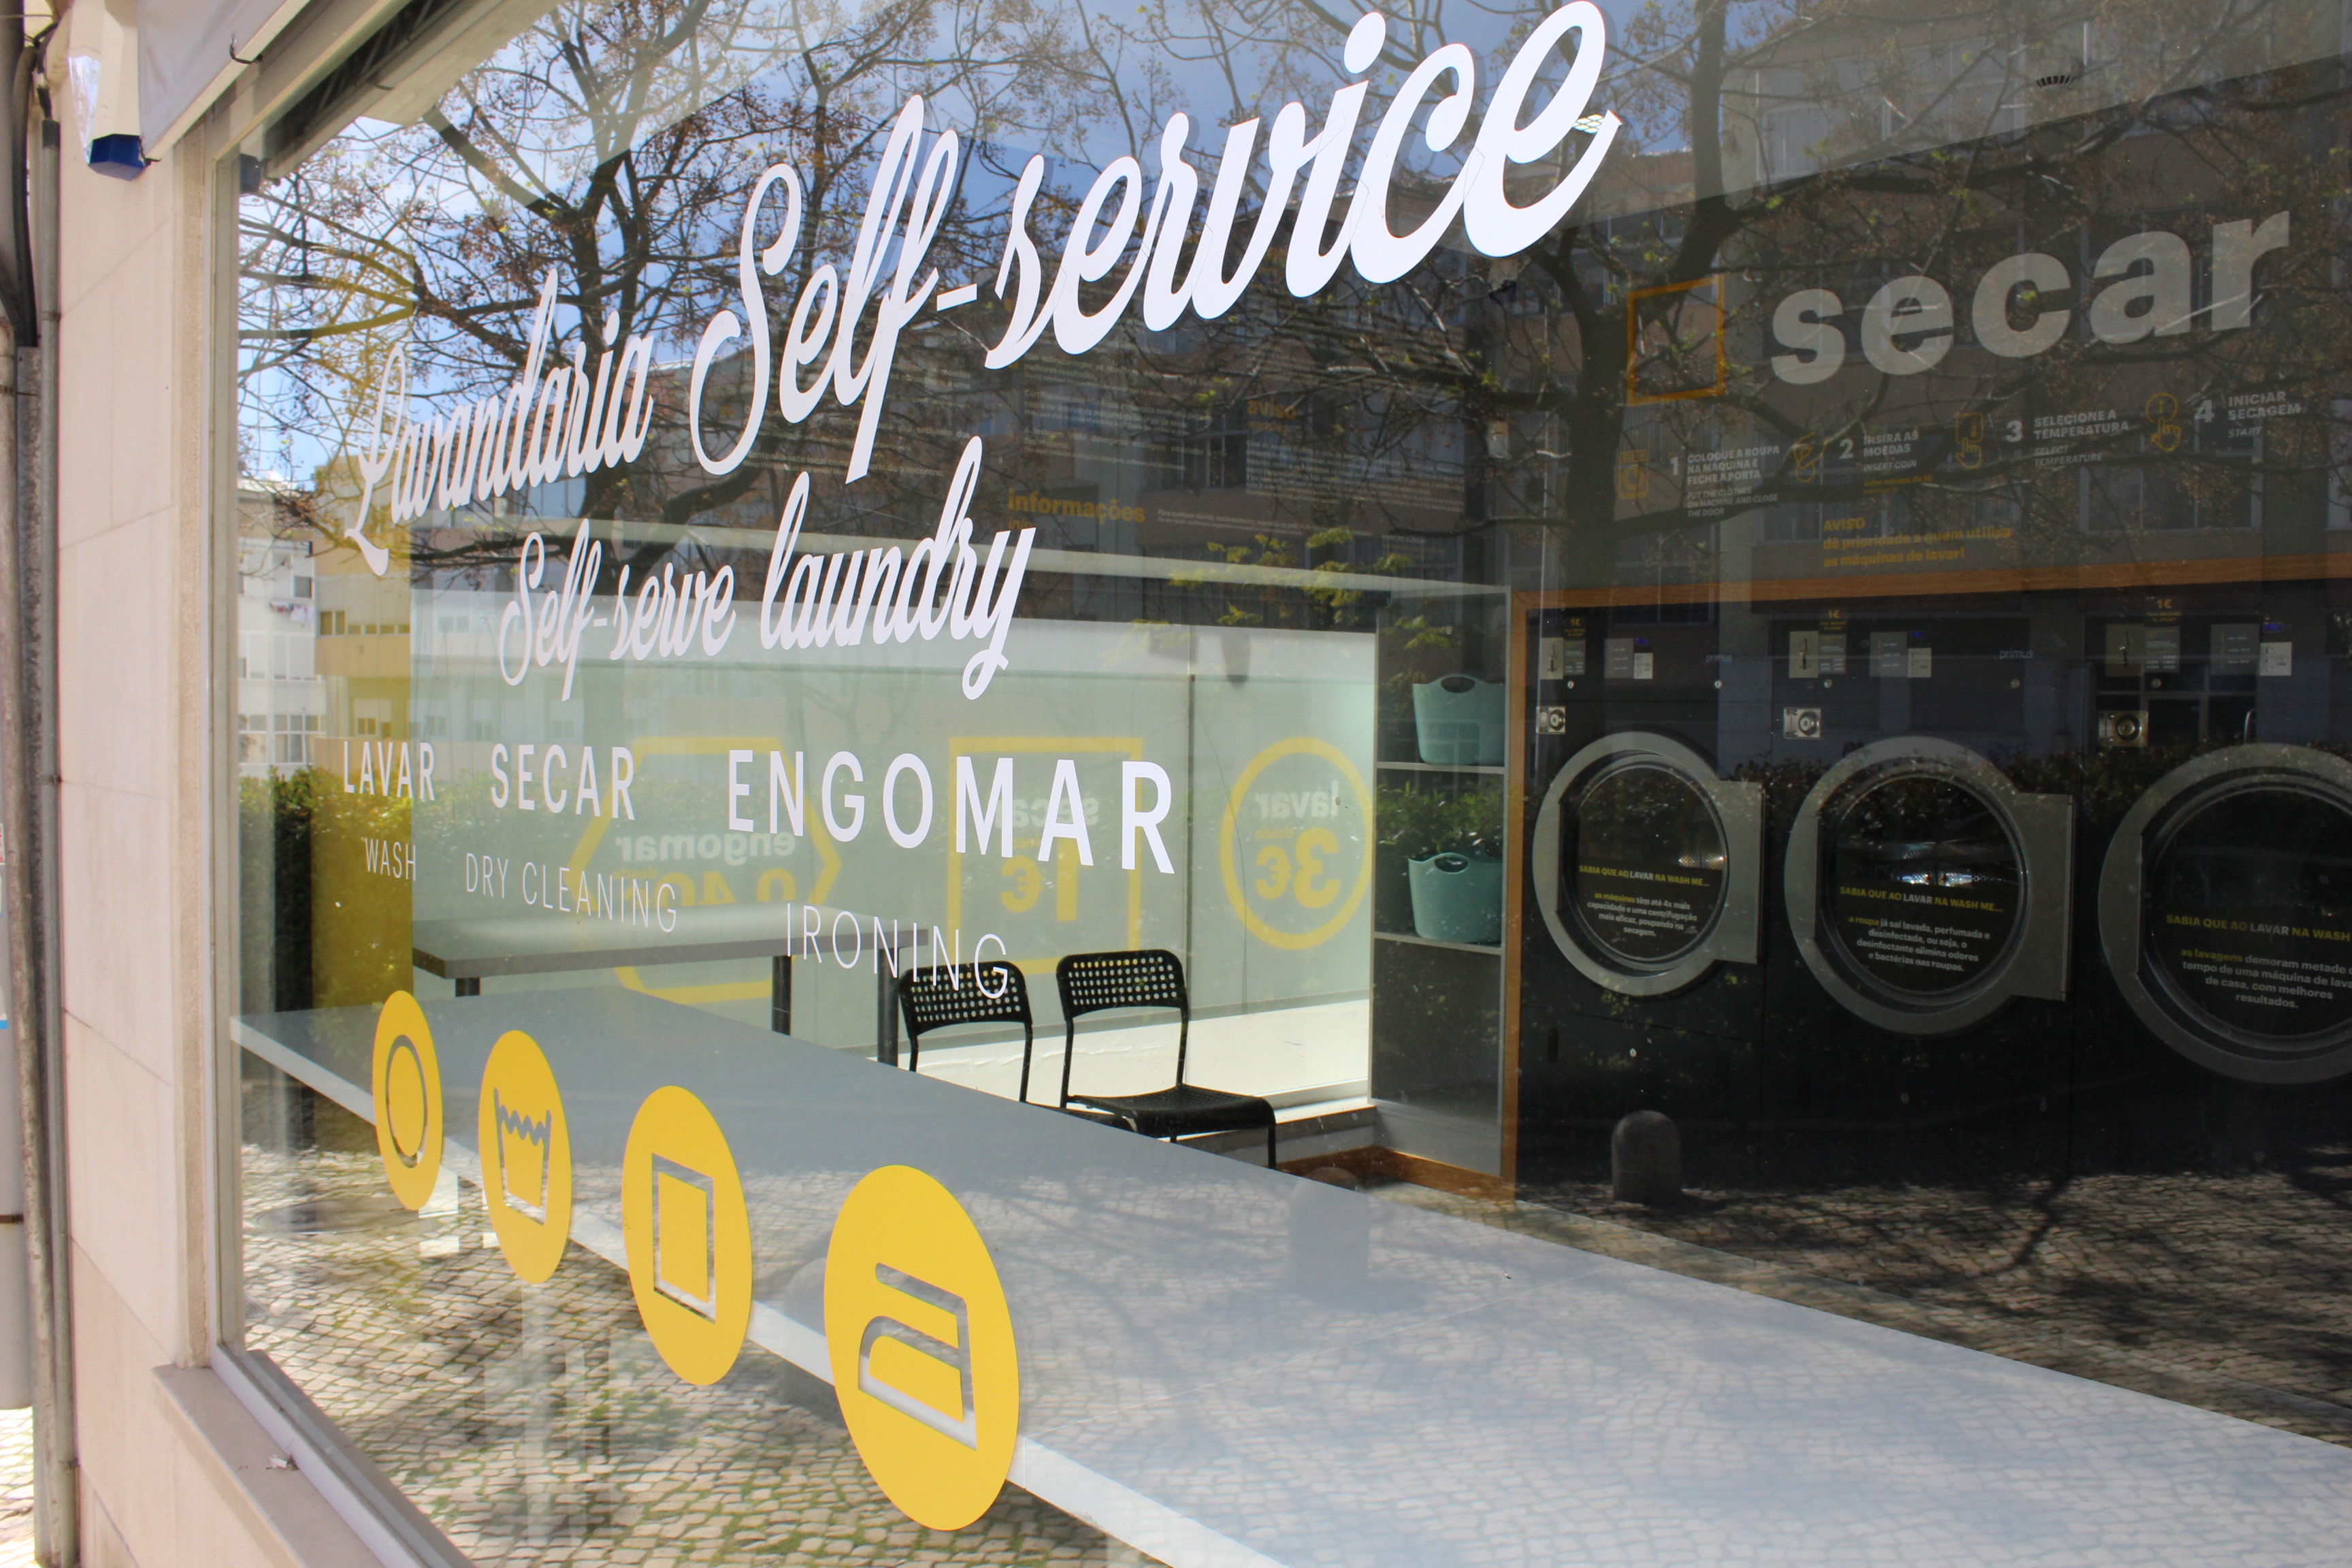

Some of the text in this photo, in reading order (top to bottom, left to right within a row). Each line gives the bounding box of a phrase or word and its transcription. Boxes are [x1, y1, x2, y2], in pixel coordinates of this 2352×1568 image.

[344, 1, 1622, 576] Lavandaria Self-service
[1771, 211, 2289, 385] secar
[2228, 391, 2287, 408] INICIAR
[2034, 410, 2117, 429] SELECIONE A
[2195, 399, 2215, 424] 4
[2227, 403, 2302, 421] SECAGEM
[1863, 429, 1920, 446] INSIRA AS
[2006, 419, 2023, 442] 3
[2034, 421, 2129, 440] TEMPERATURA
[2227, 426, 2262, 440] START
[1686, 449, 1735, 464] COLOQUE
[1744, 444, 1780, 457] ROUPA
[1839, 437, 1855, 460] 2
[1863, 443, 1912, 457] MOEDAS
[2034, 445, 2070, 457] SELECT
[1670, 455, 1679, 476] 1
[1863, 459, 1918, 472] INSERT COIN
[2034, 453, 2103, 468] TEMPERATURE
[1686, 473, 1718, 486] FECHE
[1728, 469, 1762, 481] PORTA
[1703, 489, 1718, 498] THE
[1735, 495, 1752, 504] AND
[1752, 493, 1779, 503] CLOSE
[1008, 487, 1146, 525] informações
[1687, 508, 1725, 518] THE DOOR
[1823, 517, 1866, 532] AVISO
[1842, 532, 1912, 551] prioridade
[1923, 529, 1963, 544] quem
[1823, 546, 1965, 568] as máquinas de lavar!
[499, 436, 1036, 702] Self-serve laundry
[2156, 598, 2172, 609] 1€
[1999, 648, 2034, 659] primus
[344, 740, 1175, 875] LAVAR SECAR ENGOMAR
[365, 837, 416, 881] WASH
[1578, 864, 1601, 875] SABIA
[1601, 867, 1618, 877] QUE
[1618, 869, 1629, 879] AO
[1630, 870, 1654, 881] LAVAR
[1654, 873, 1666, 882] NA
[1667, 875, 1690, 885] WASH
[466, 852, 677, 933] DRY CLEANING
[1603, 894, 1635, 904] máquinas
[1650, 898, 1662, 906] até
[1663, 899, 1672, 907] 4x
[1673, 900, 1690, 910] mais
[1839, 885, 2004, 913] SABIA QUE AO LAVAR NA WASH ME...
[1587, 900, 1626, 913] capacidade
[1631, 907, 1647, 915] uma
[1648, 909, 1697, 922] centrifugação
[1599, 912, 1614, 921] mais
[1638, 919, 1674, 930] poupando
[1674, 922, 1684, 930] na
[1623, 926, 1657, 937] secagem.
[1855, 917, 1879, 927] roupa
[1880, 918, 1889, 928] já
[1889, 919, 1901, 929] sai
[1903, 920, 1933, 933] lavada,
[1933, 926, 1982, 939] perfumada
[2166, 913, 2352, 942] SABIA QUE AO LAVAR NA WASH
[1867, 928, 1925, 944] desinfectada,
[1926, 936, 1938, 945] ou
[1939, 938, 1959, 949] seja,
[785, 902, 1010, 1000] IRONING
[1856, 938, 1979, 962] desinfectante elimina odores
[1875, 951, 1914, 965] bactérias
[1915, 958, 1931, 967] nas
[1931, 960, 1965, 972] roupas.
[2180, 948, 2193, 958] as
[2194, 947, 2243, 963] lavagens
[2244, 954, 2299, 969] demoram
[2301, 960, 2347, 975] metade
[2182, 960, 2352, 989] tempo de uma máquina de lava
[2204, 975, 2334, 1000] de casa, com melhores
[2235, 993, 2300, 1009] resultados.
